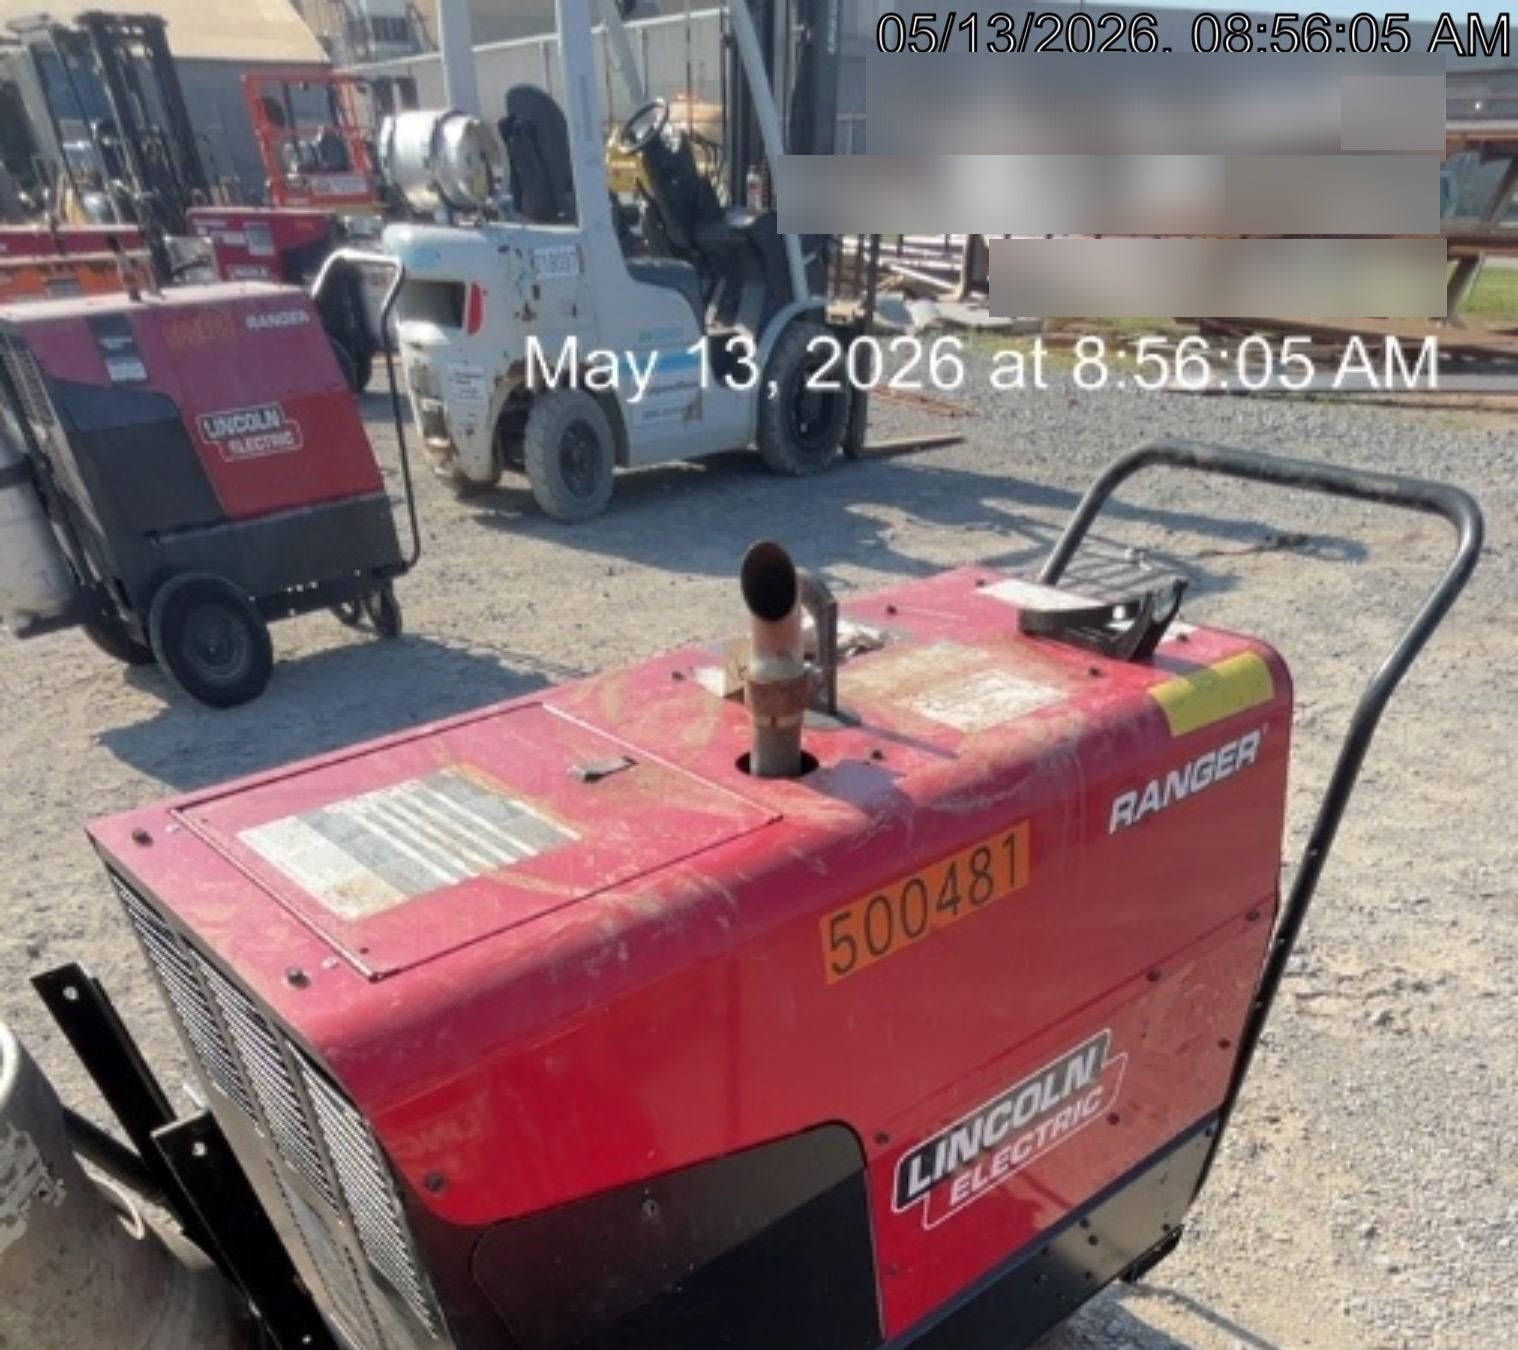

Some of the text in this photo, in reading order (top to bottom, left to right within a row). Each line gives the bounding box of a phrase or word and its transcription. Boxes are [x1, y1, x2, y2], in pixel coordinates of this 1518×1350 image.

[203, 409, 280, 439] LINCOLN
[1108, 729, 1261, 835] RANGER
[828, 832, 1016, 976] 500481
[906, 1045, 1100, 1198] LINCOLN
[949, 1085, 1105, 1206] ELECTRIC
